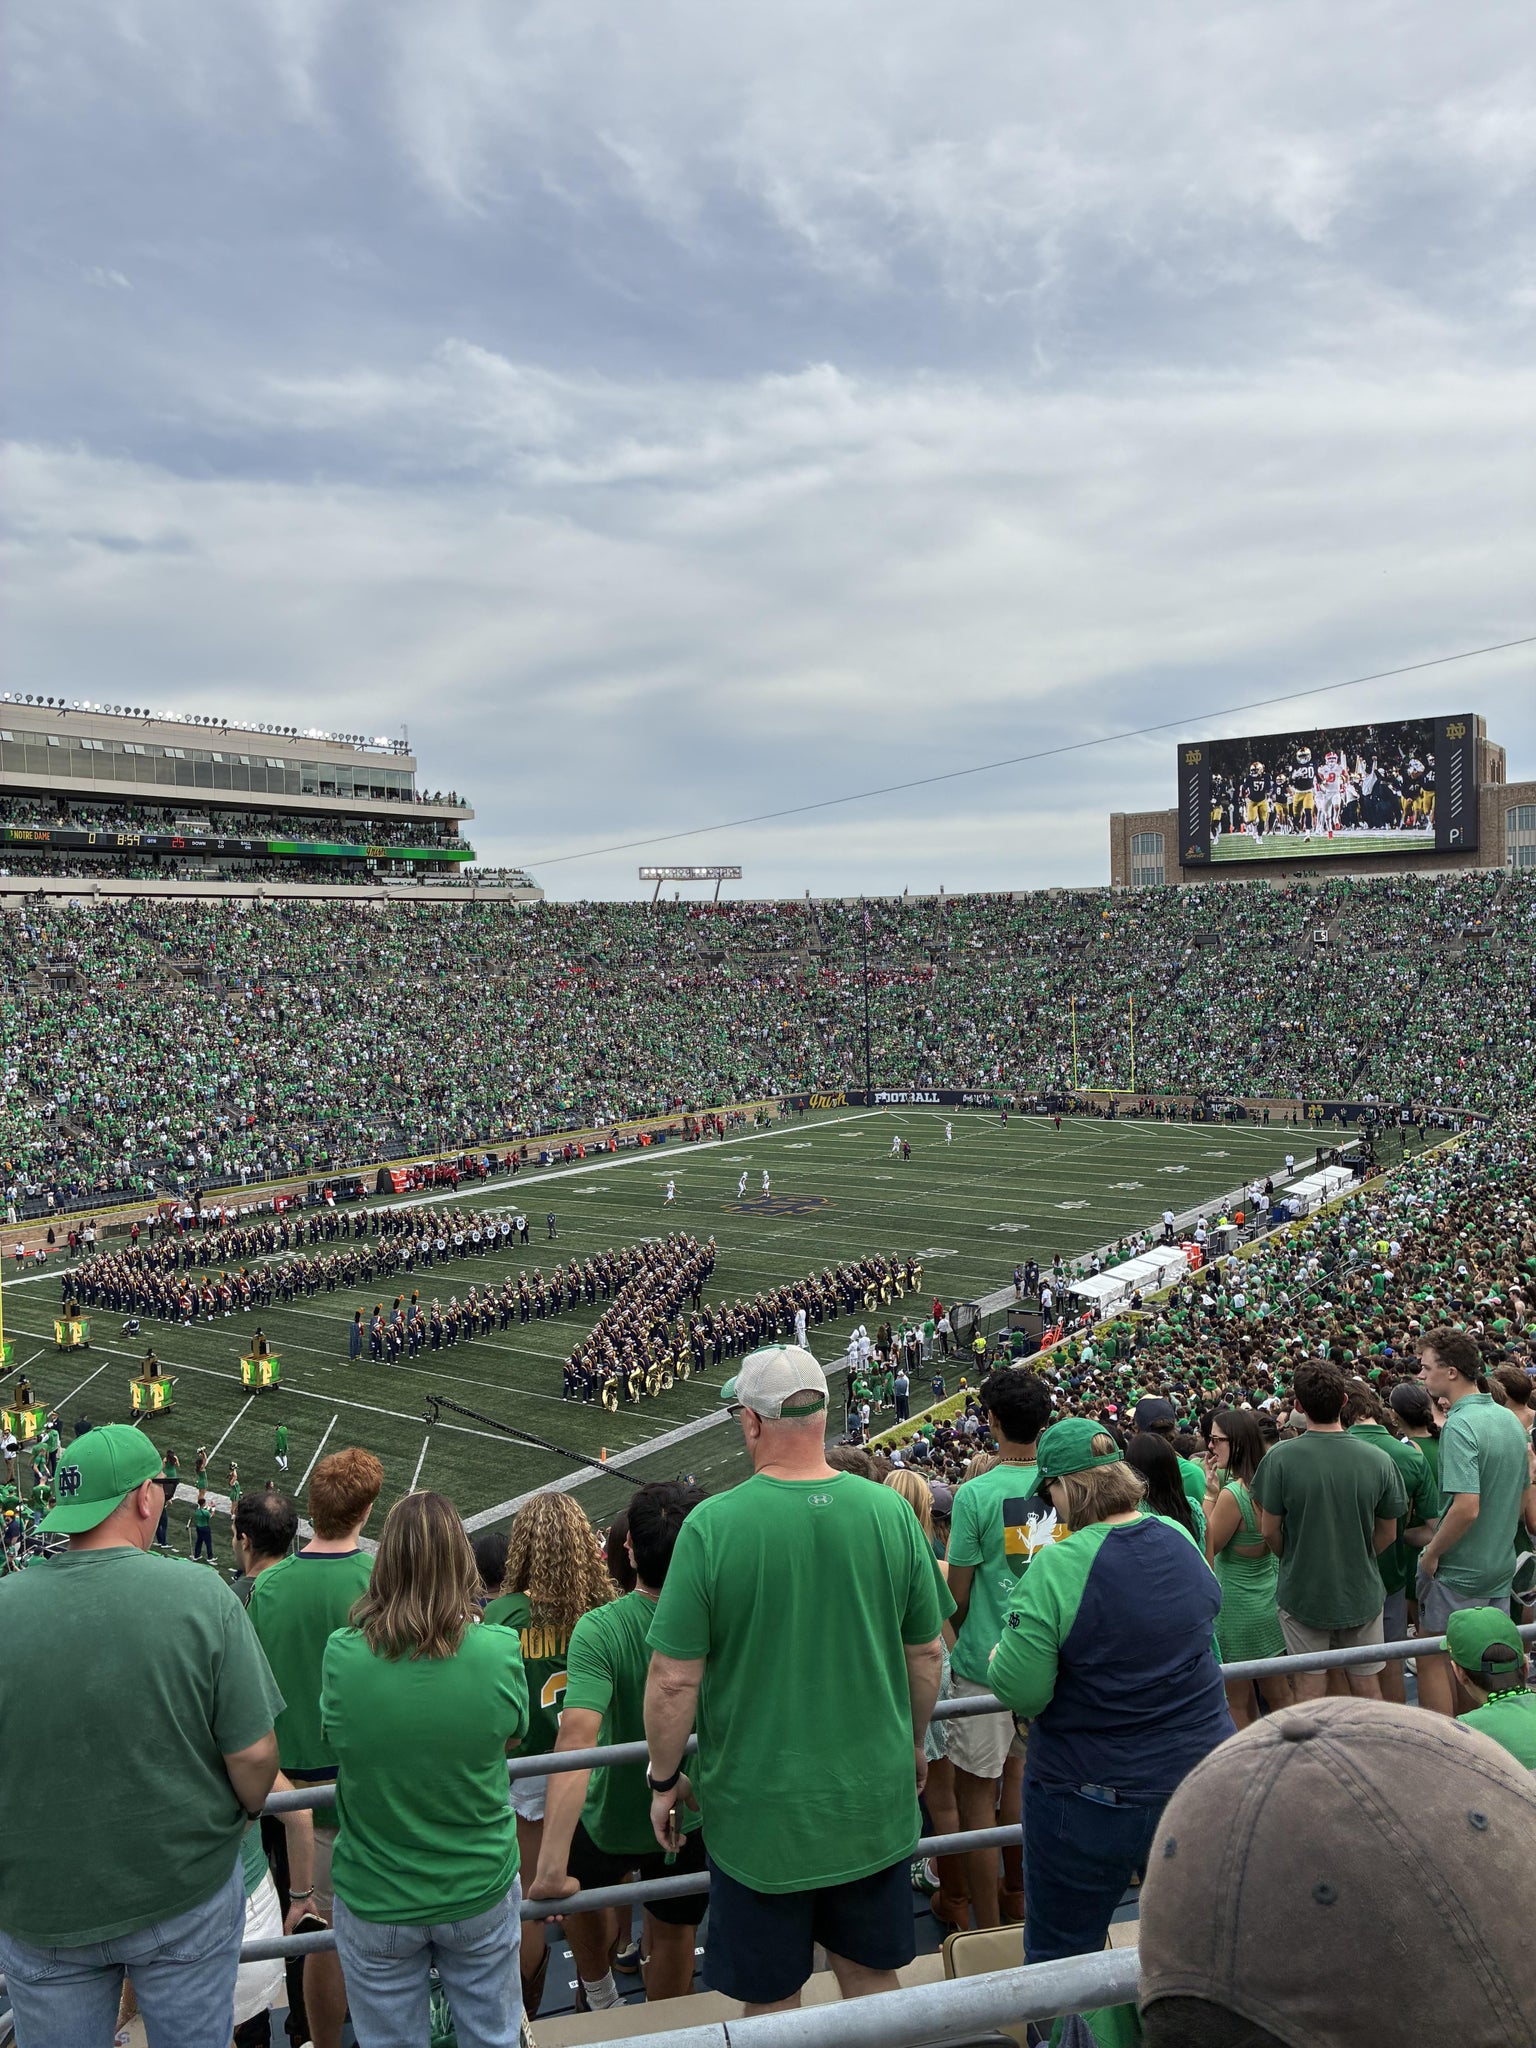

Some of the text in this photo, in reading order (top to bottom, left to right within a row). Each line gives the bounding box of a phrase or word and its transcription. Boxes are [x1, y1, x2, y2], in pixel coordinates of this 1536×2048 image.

[1253, 781, 1264, 791] 57
[13, 830, 33, 840] NOTRE
[34, 831, 51, 841] DAME
[117, 834, 140, 846] 8:59
[808, 1092, 849, 1109] Irih
[59, 1464, 83, 1498] ND
